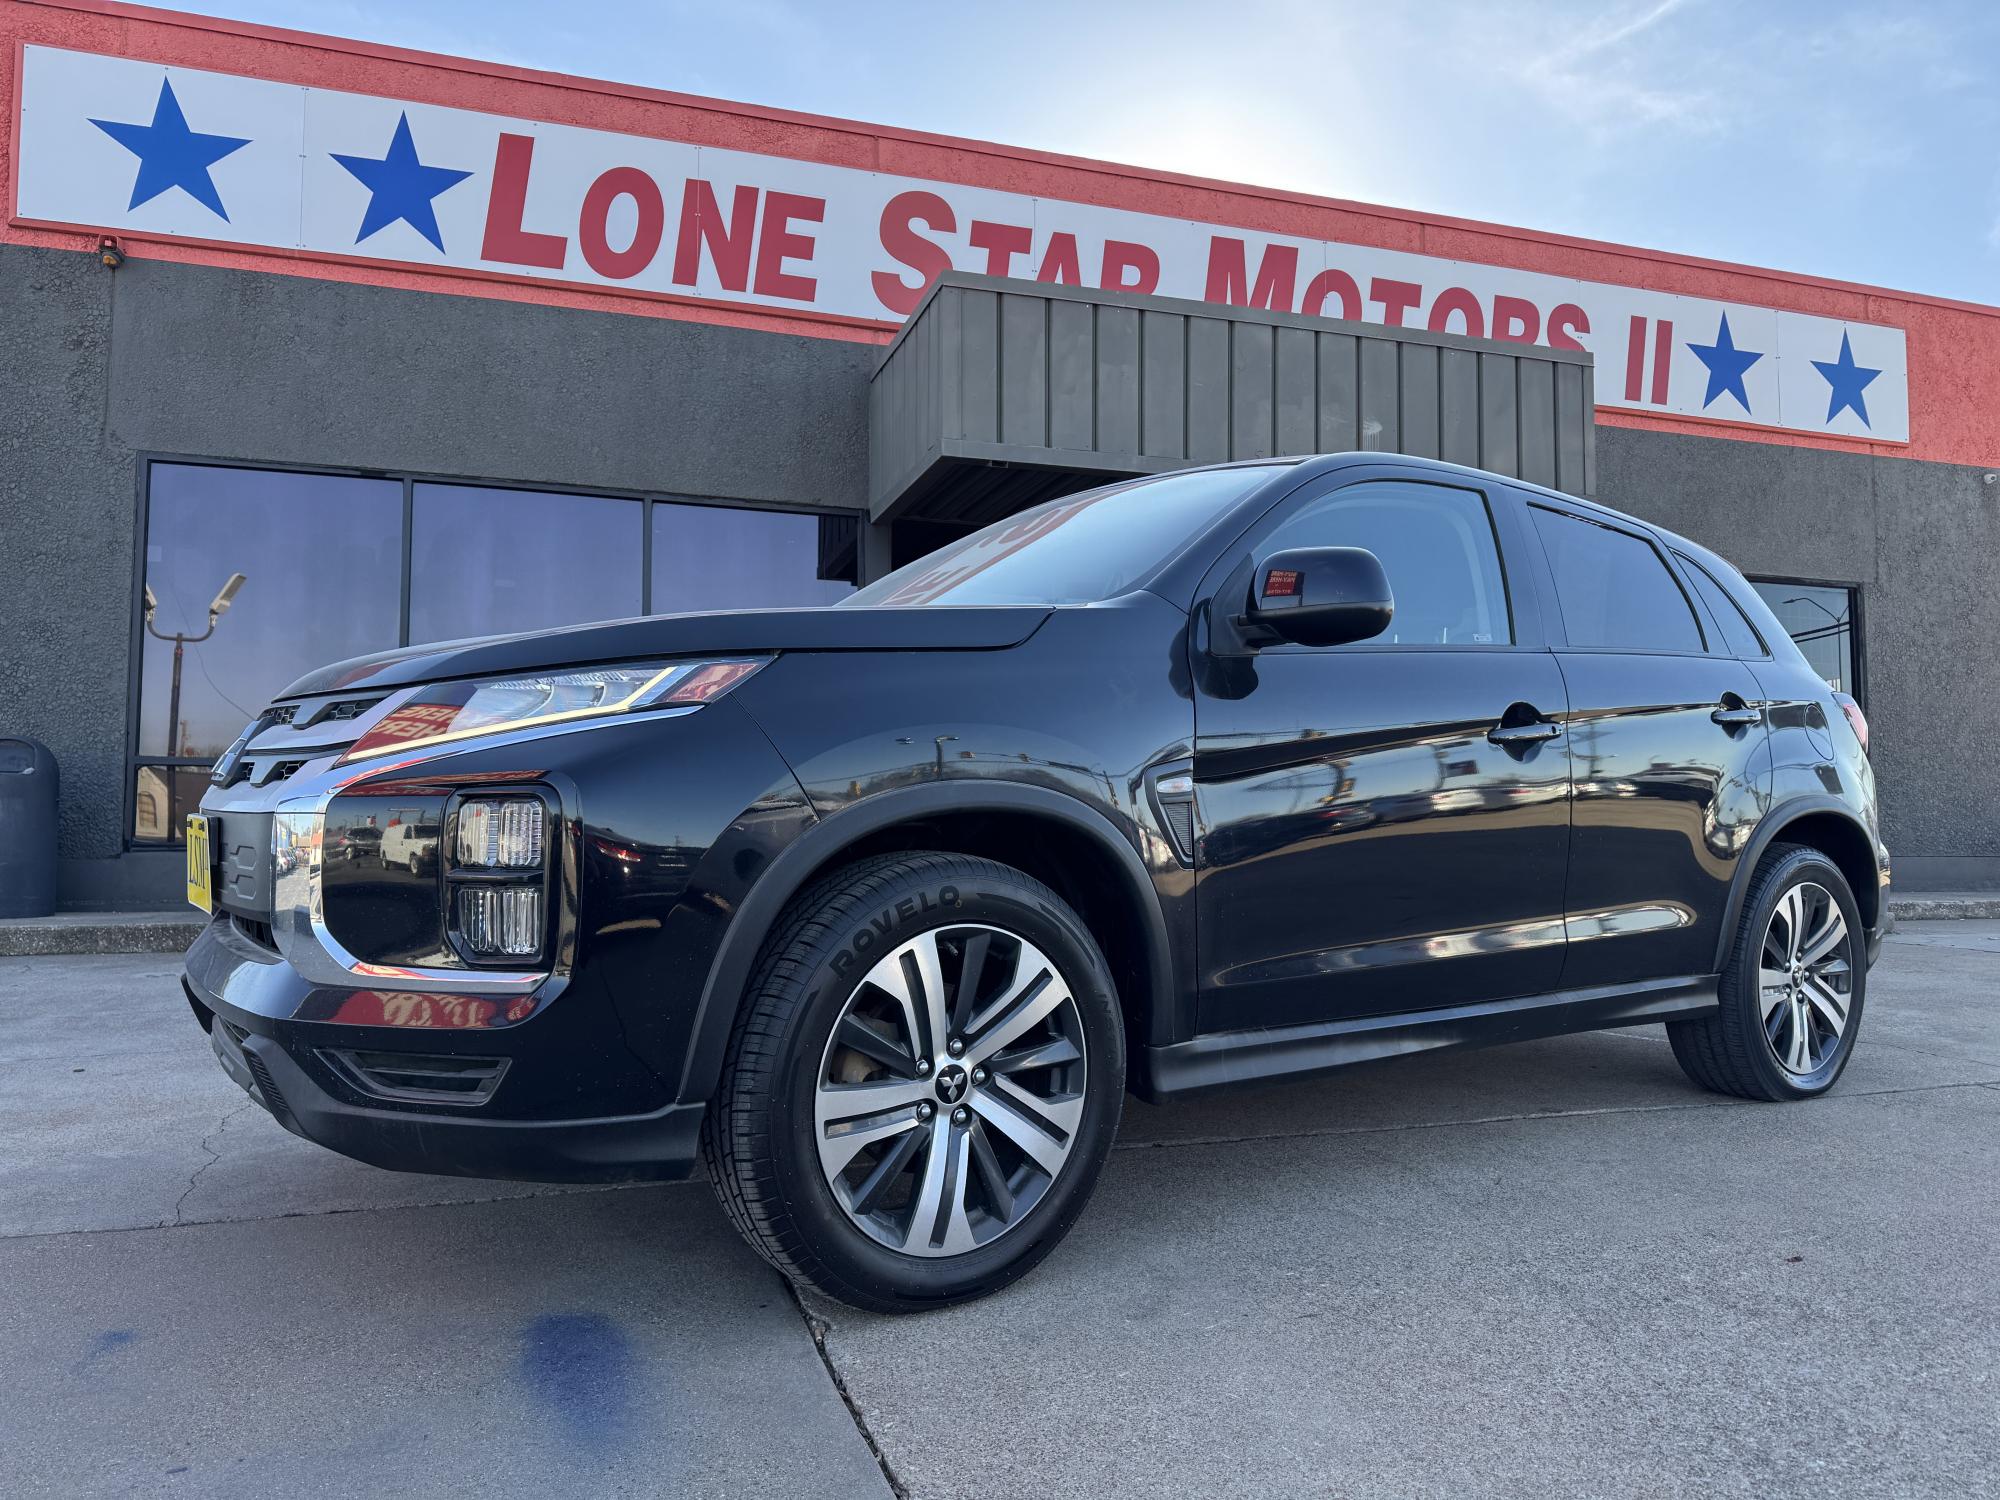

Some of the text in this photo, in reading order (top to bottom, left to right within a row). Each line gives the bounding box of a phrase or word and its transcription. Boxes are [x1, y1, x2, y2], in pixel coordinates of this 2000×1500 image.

[481, 132, 826, 302] LONE
[1625, 315, 1673, 405] II
[829, 885, 960, 977] ROVELO
